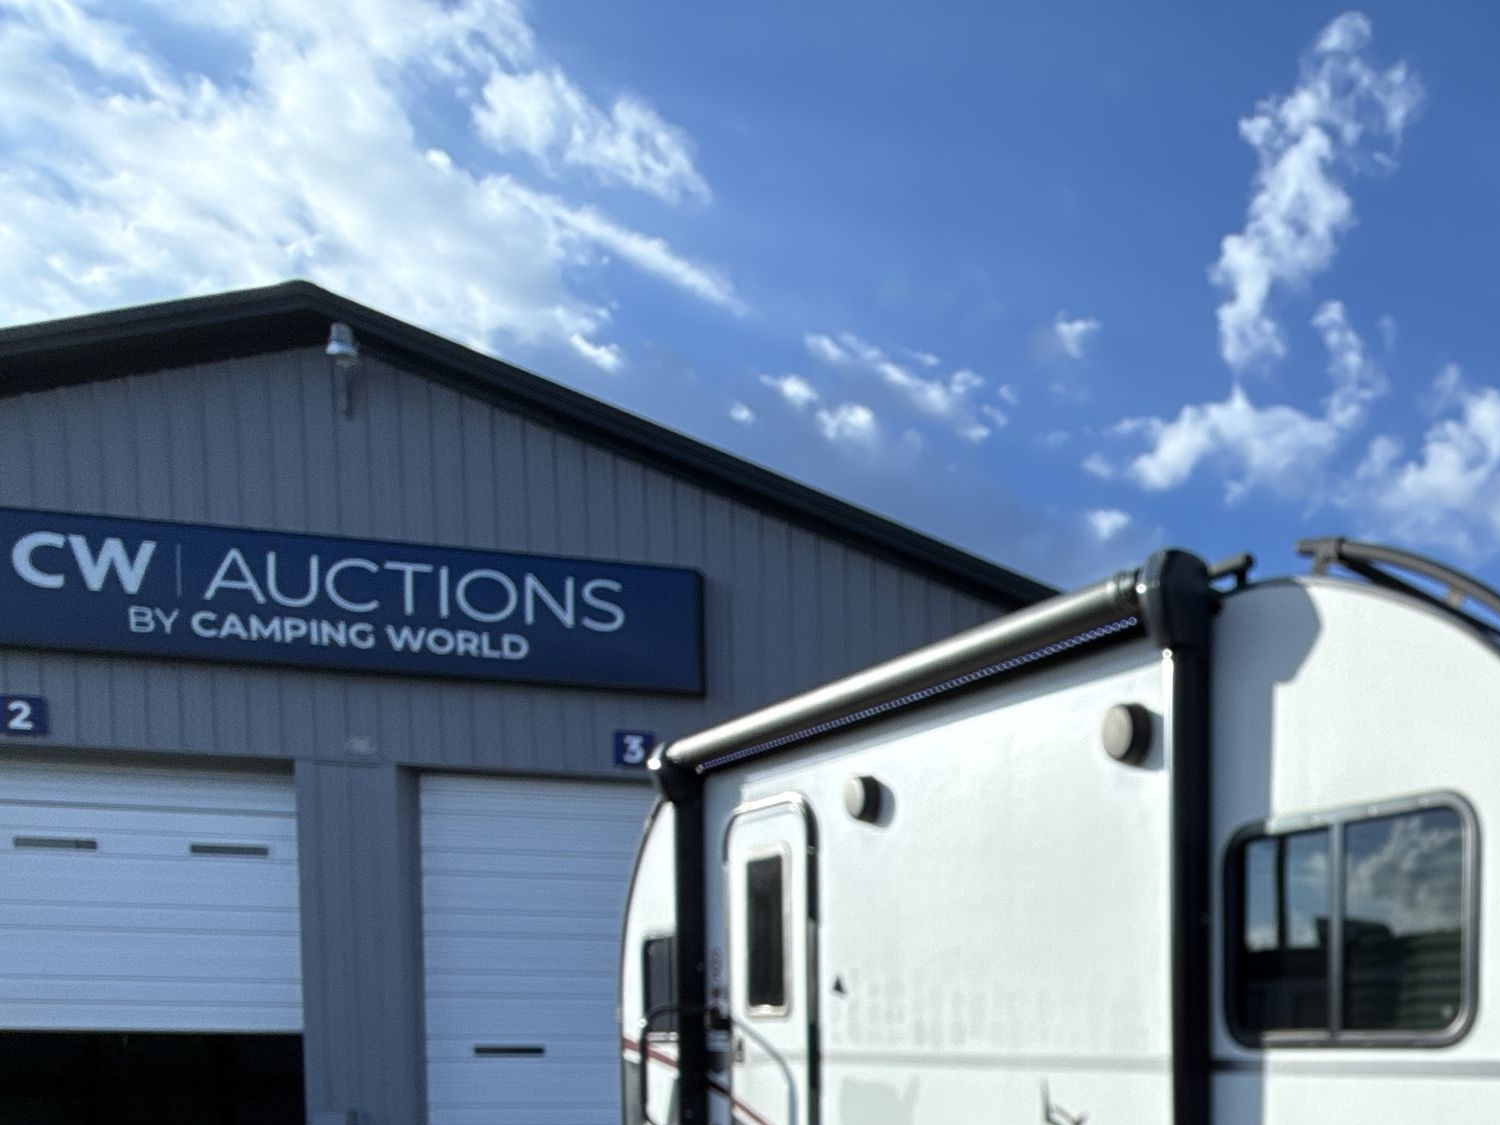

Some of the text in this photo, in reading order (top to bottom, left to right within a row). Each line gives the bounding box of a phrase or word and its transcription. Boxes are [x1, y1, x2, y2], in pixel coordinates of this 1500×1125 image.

[11, 531, 625, 632] CW AUCTIONS
[128, 605, 529, 660] BY CAMPING WORLD
[8, 700, 33, 730] 2
[623, 734, 645, 764] 3
